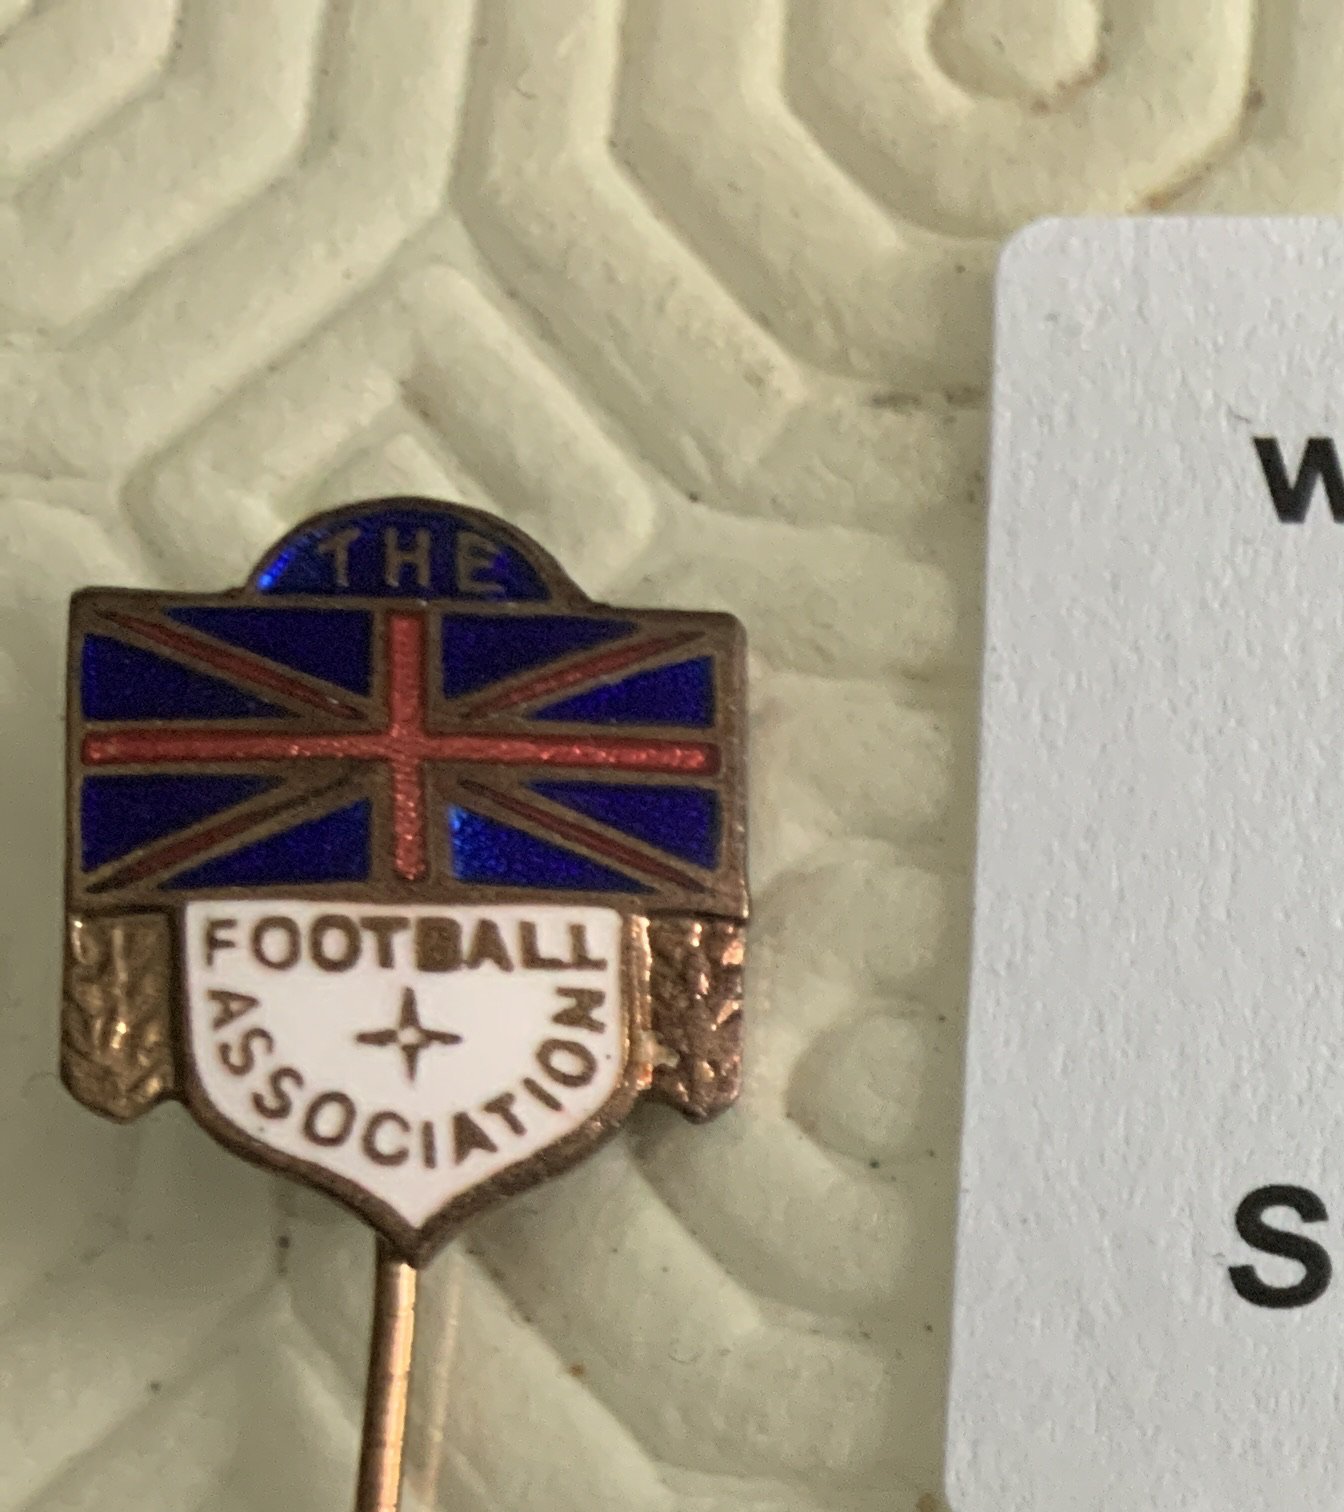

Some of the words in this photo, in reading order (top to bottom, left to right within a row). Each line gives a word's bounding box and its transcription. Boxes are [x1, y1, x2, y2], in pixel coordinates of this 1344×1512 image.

[316, 526, 508, 594] THE
[203, 913, 609, 973] FOOTBALL
[203, 985, 608, 1170] ASSOCIATION
